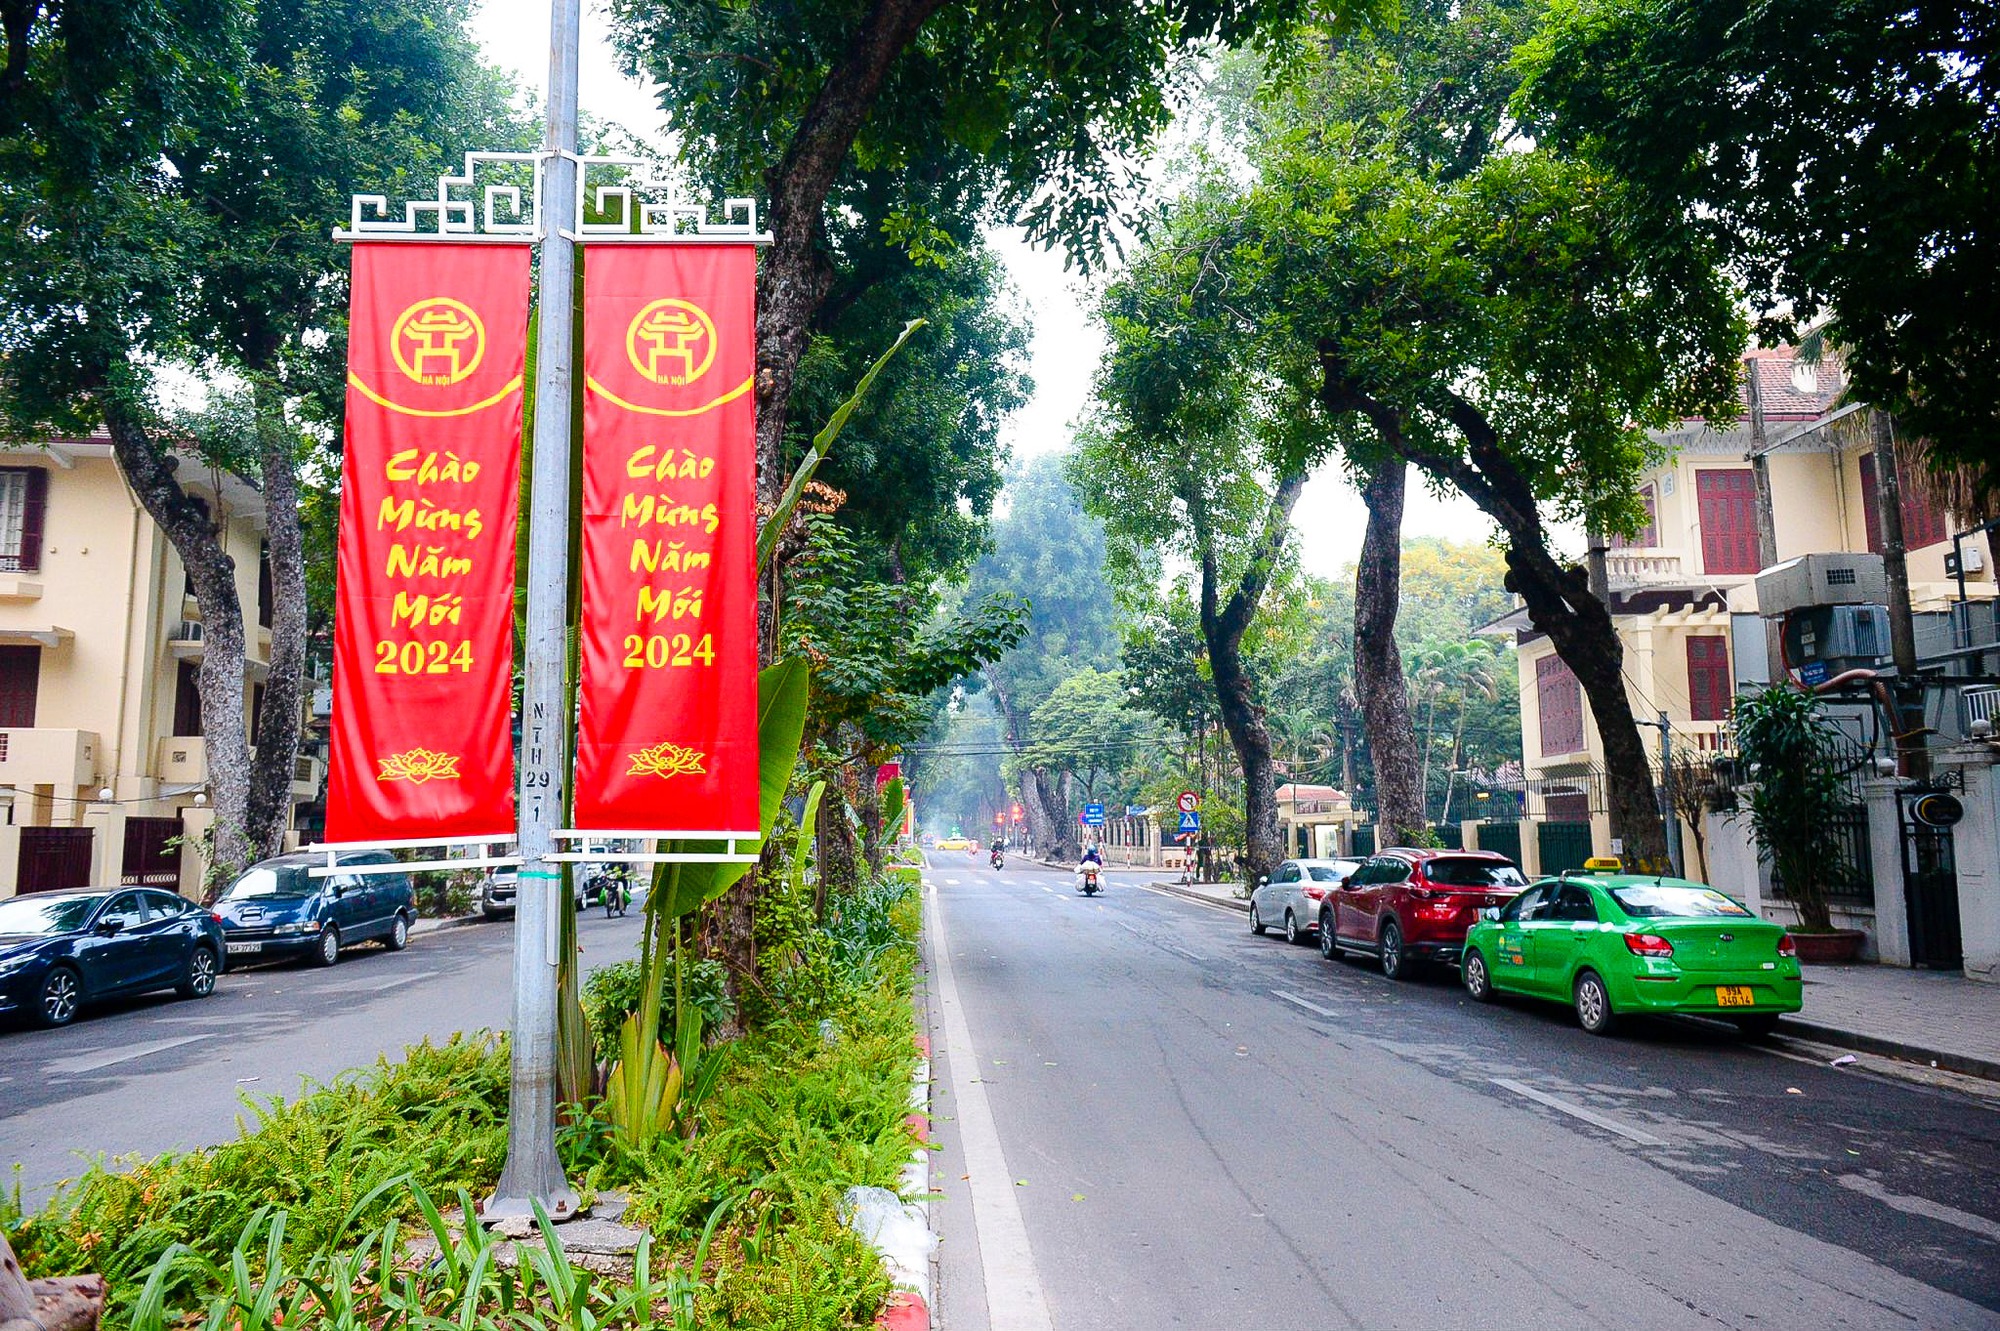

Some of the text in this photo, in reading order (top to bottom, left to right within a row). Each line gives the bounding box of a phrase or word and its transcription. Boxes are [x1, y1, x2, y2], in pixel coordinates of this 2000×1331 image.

[386, 449, 480, 485] Chào
[626, 445, 715, 482] Chào
[377, 496, 483, 540] Mừng
[621, 492, 719, 534] Mừng
[386, 544, 472, 578] Năm
[630, 538, 710, 573] Năm
[391, 591, 462, 628] Mới
[636, 585, 703, 623] Mới
[375, 640, 474, 675] 2024
[623, 633, 715, 668] 2024
